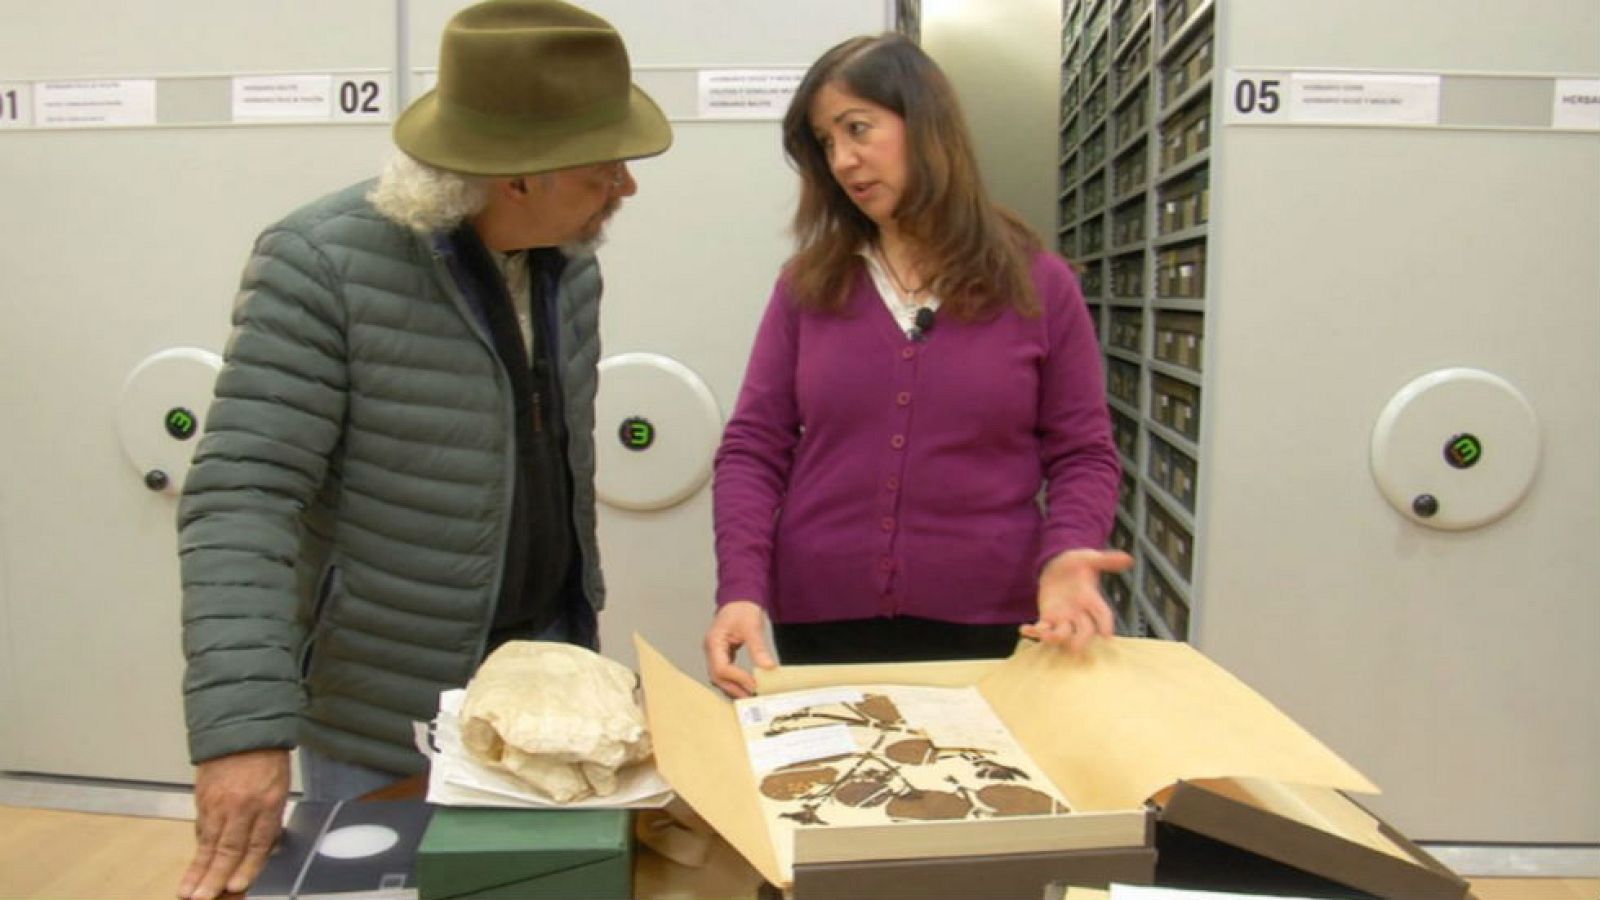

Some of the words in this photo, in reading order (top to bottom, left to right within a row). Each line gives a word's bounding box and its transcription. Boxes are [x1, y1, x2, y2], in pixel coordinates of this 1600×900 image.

[0, 89, 17, 120] 1
[340, 80, 380, 113] 02
[1234, 79, 1281, 114] 05
[1561, 95, 1600, 105] HERBA
